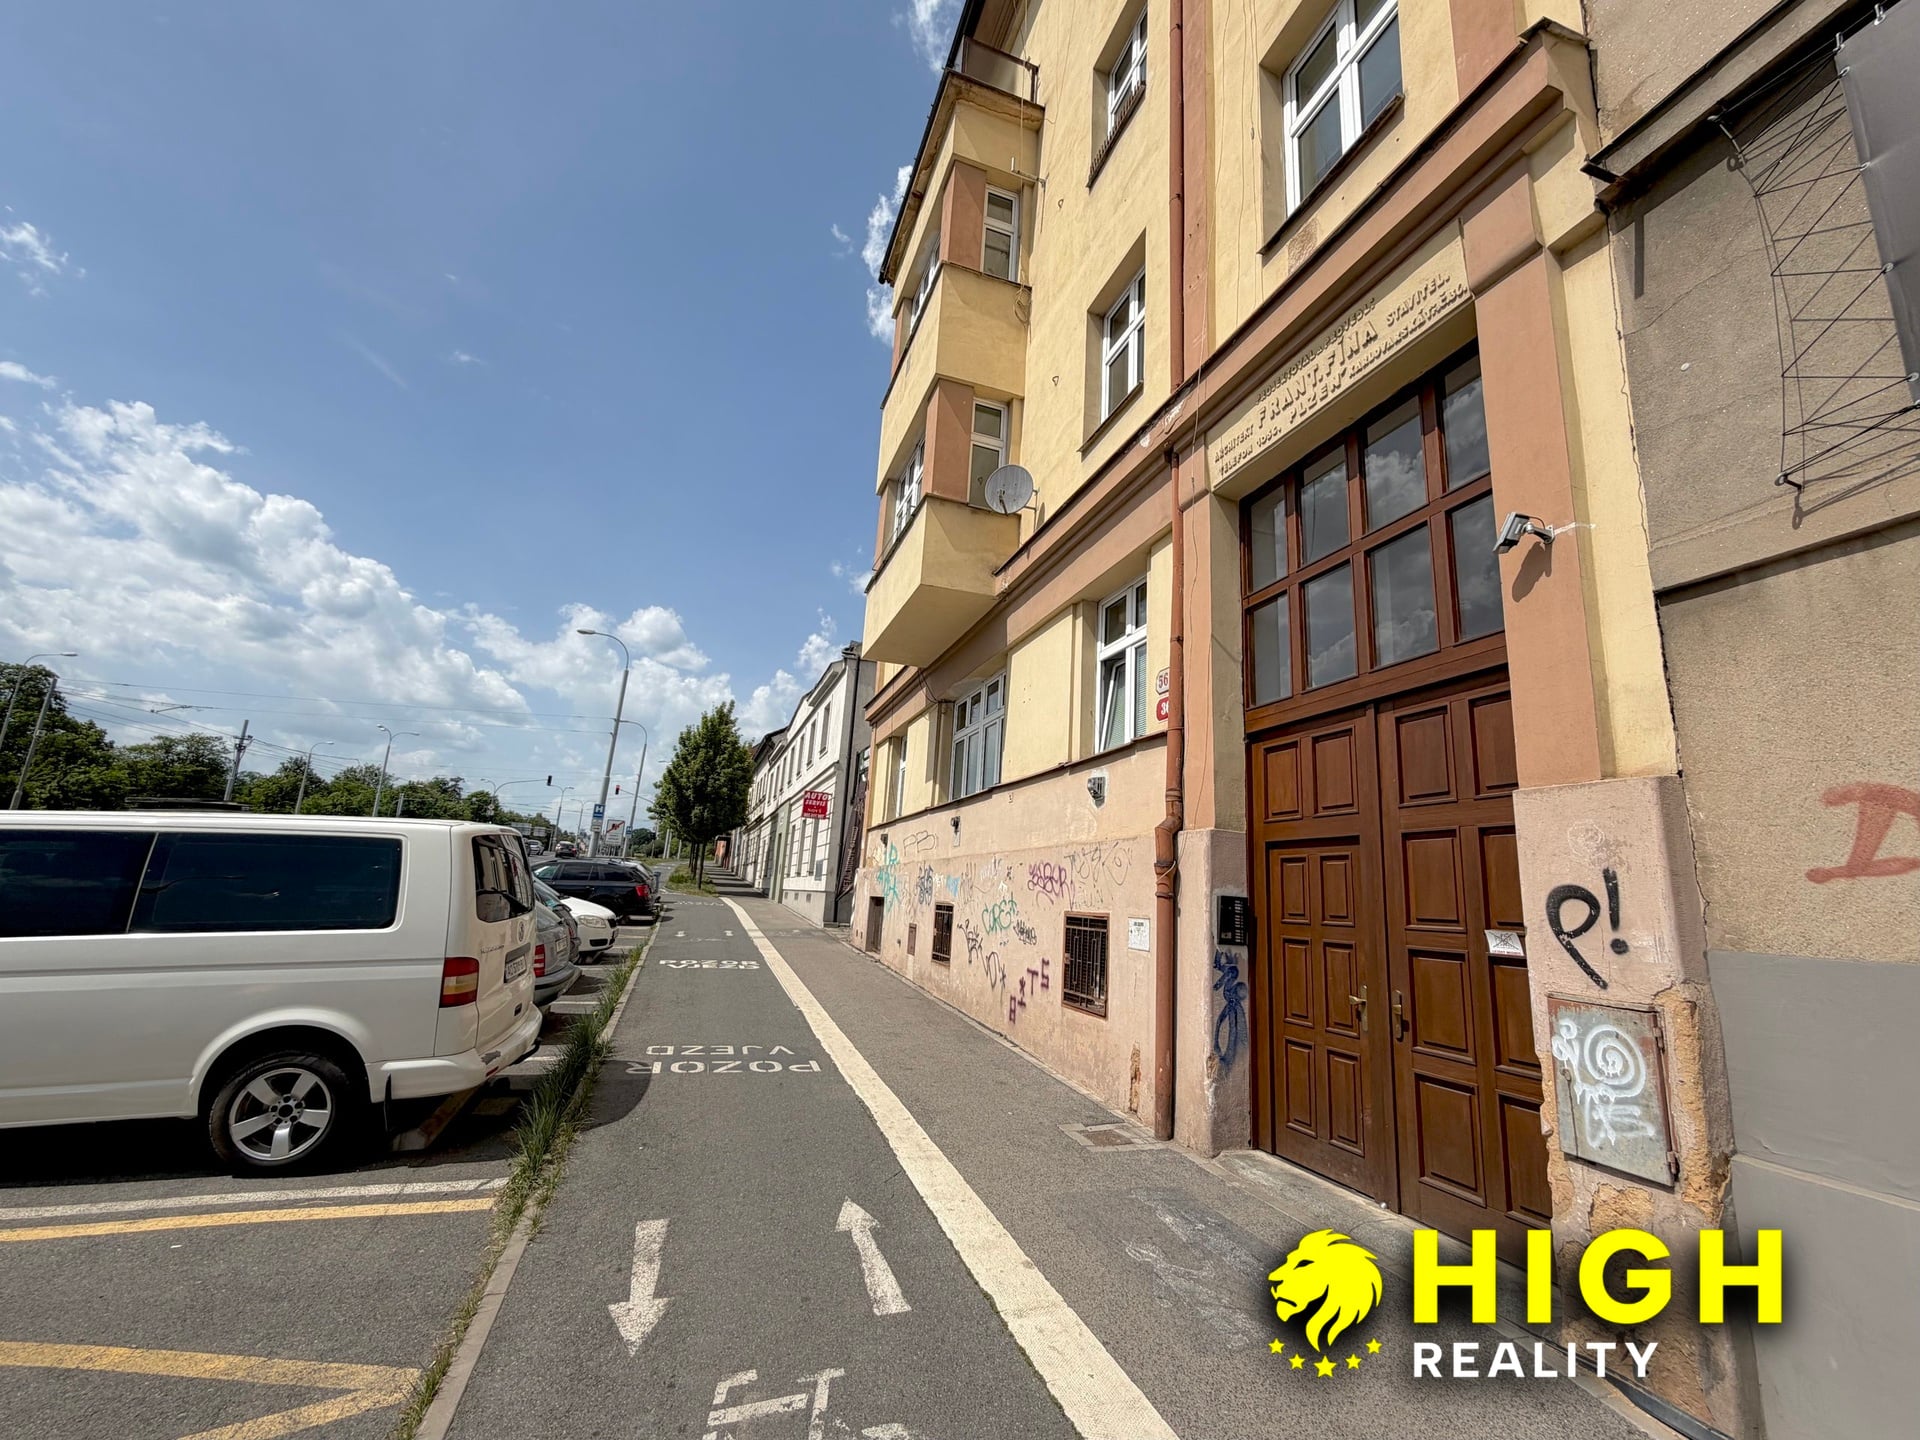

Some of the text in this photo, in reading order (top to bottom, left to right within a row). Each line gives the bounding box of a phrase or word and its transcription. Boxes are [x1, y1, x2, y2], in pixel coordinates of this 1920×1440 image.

[1219, 444, 1254, 476] TELEFON
[804, 792, 828, 801] AUTO
[646, 1045, 795, 1056] VJEZD
[625, 1060, 822, 1075] POZOR
